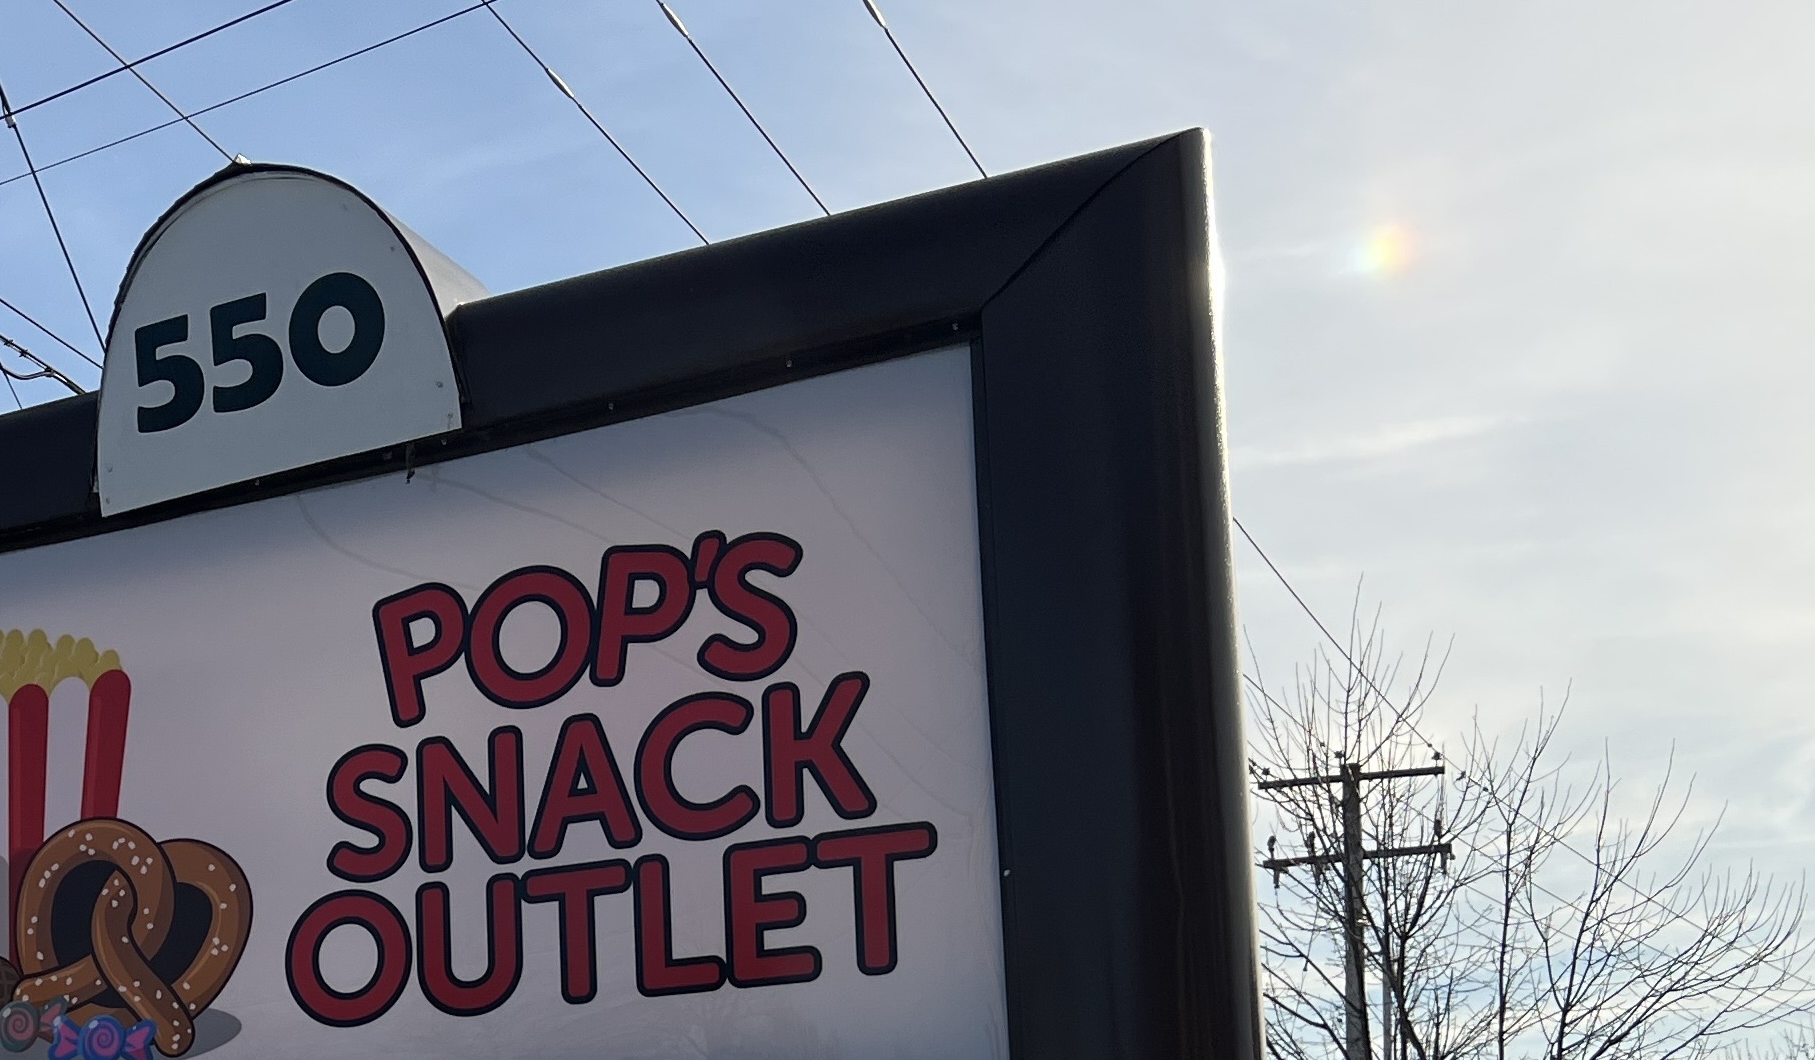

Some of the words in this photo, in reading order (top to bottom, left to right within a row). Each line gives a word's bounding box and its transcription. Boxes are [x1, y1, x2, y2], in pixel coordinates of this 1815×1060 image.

[133, 271, 386, 434] 550
[372, 530, 803, 729] POP'S
[325, 671, 878, 884] SNACK
[284, 820, 939, 1029] OUTLET
